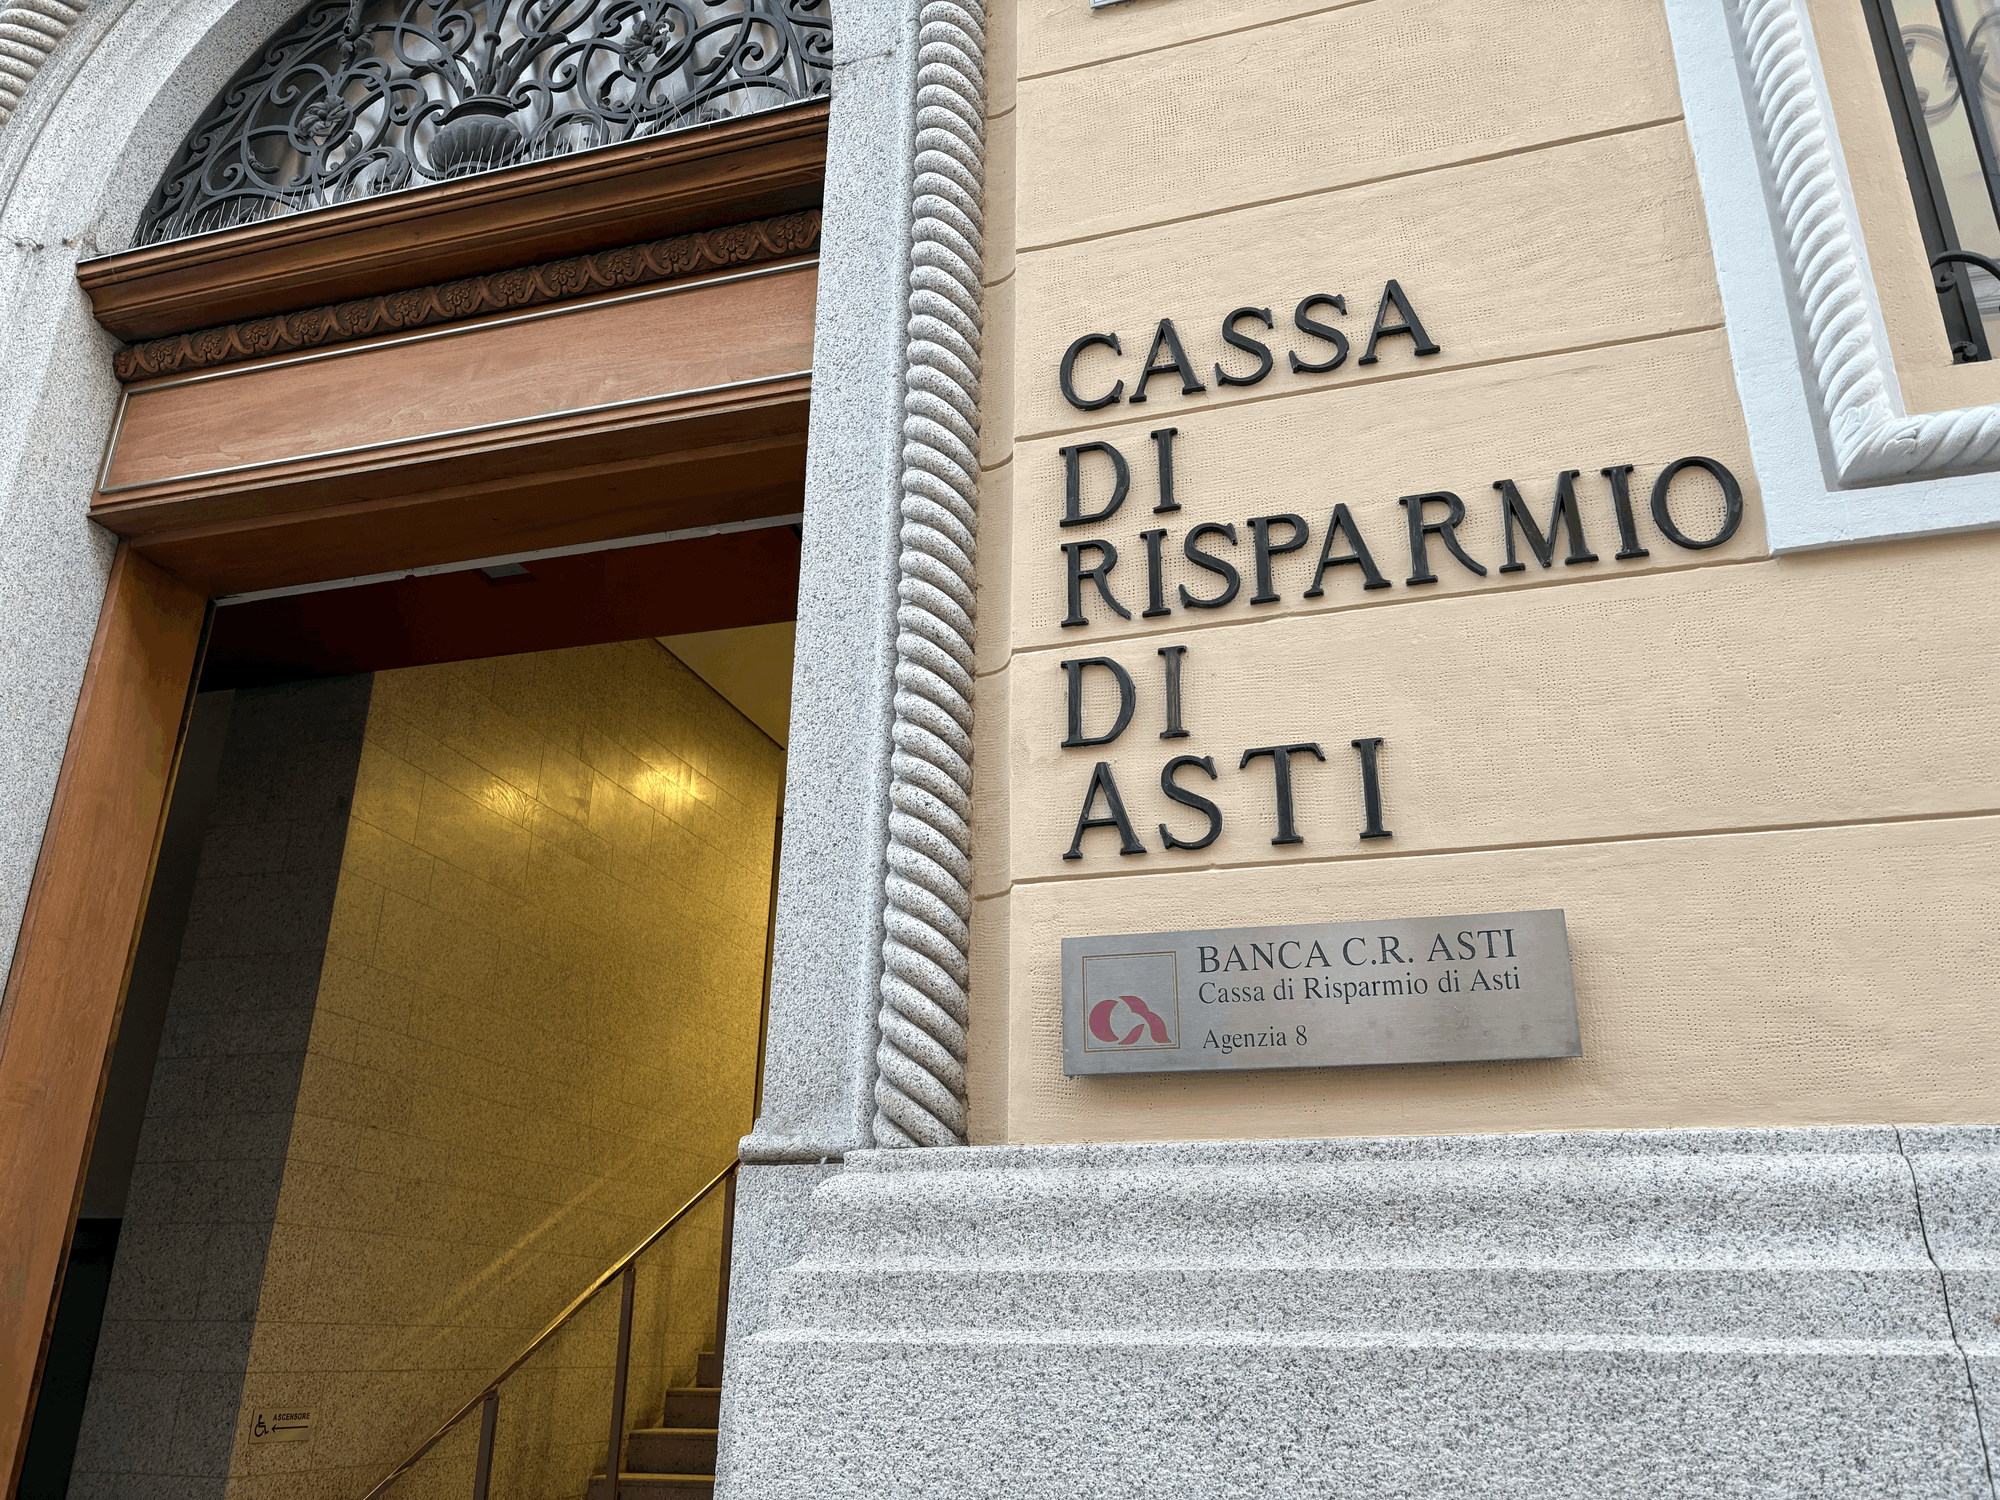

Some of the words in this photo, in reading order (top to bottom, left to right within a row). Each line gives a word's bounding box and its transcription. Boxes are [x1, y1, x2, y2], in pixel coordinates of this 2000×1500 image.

[1059, 279, 1440, 411] CASSA
[1059, 427, 1181, 527] DI
[1060, 456, 1743, 627] RISPARMIO
[1060, 645, 1190, 748] DI
[1063, 737, 1393, 860] ASTI
[1197, 939, 1332, 974] BANCA
[1342, 936, 1414, 967] C.R.
[1427, 928, 1518, 961] ASTI
[1198, 981, 1265, 1004] Cassa
[1273, 977, 1295, 1001] di
[1303, 971, 1428, 1005] Risparmio
[1438, 969, 1460, 993] di
[1470, 966, 1521, 992] Asti
[1202, 1026, 1288, 1055] Agenzia
[1296, 1024, 1309, 1047] 8
[272, 1412, 311, 1421] ASCENSORE
